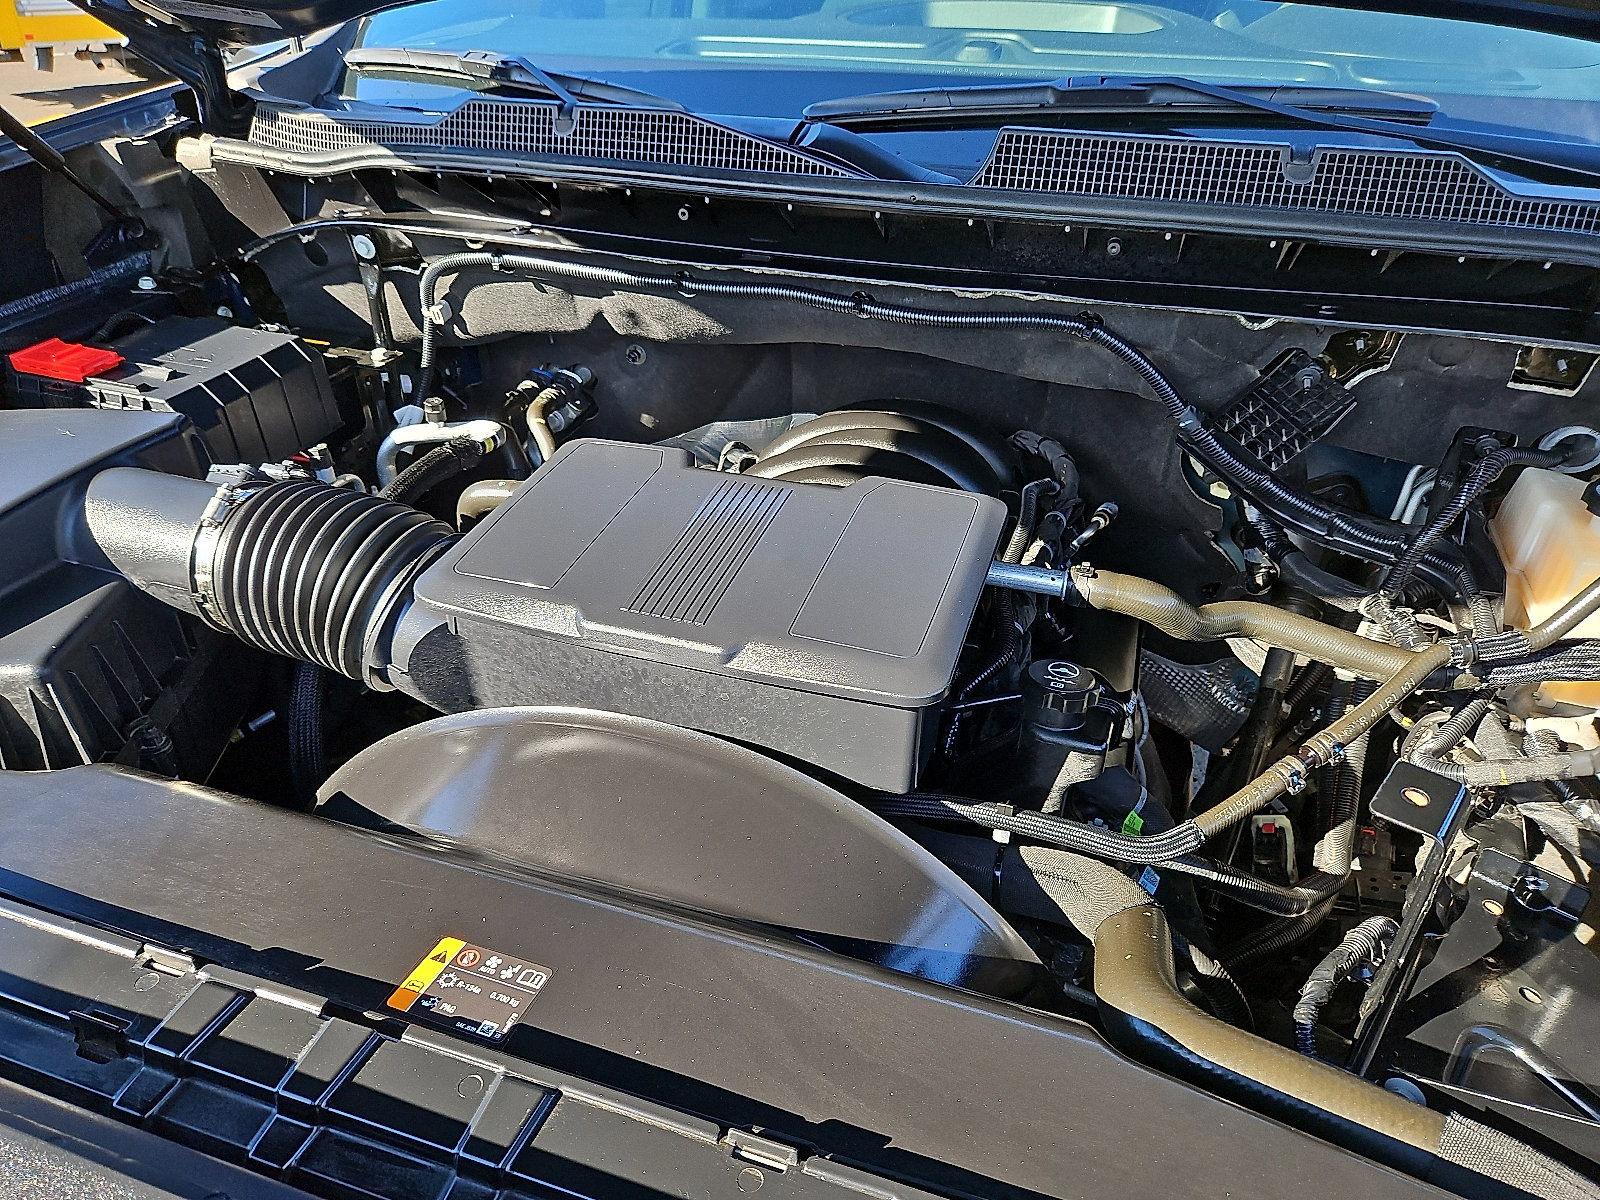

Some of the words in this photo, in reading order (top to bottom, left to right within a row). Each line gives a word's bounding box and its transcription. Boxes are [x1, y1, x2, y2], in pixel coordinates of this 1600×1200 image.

[478, 965, 497, 975] AUTO
[455, 981, 483, 995] R-134a
[489, 991, 510, 1005] 0.700
[508, 998, 522, 1008] kg
